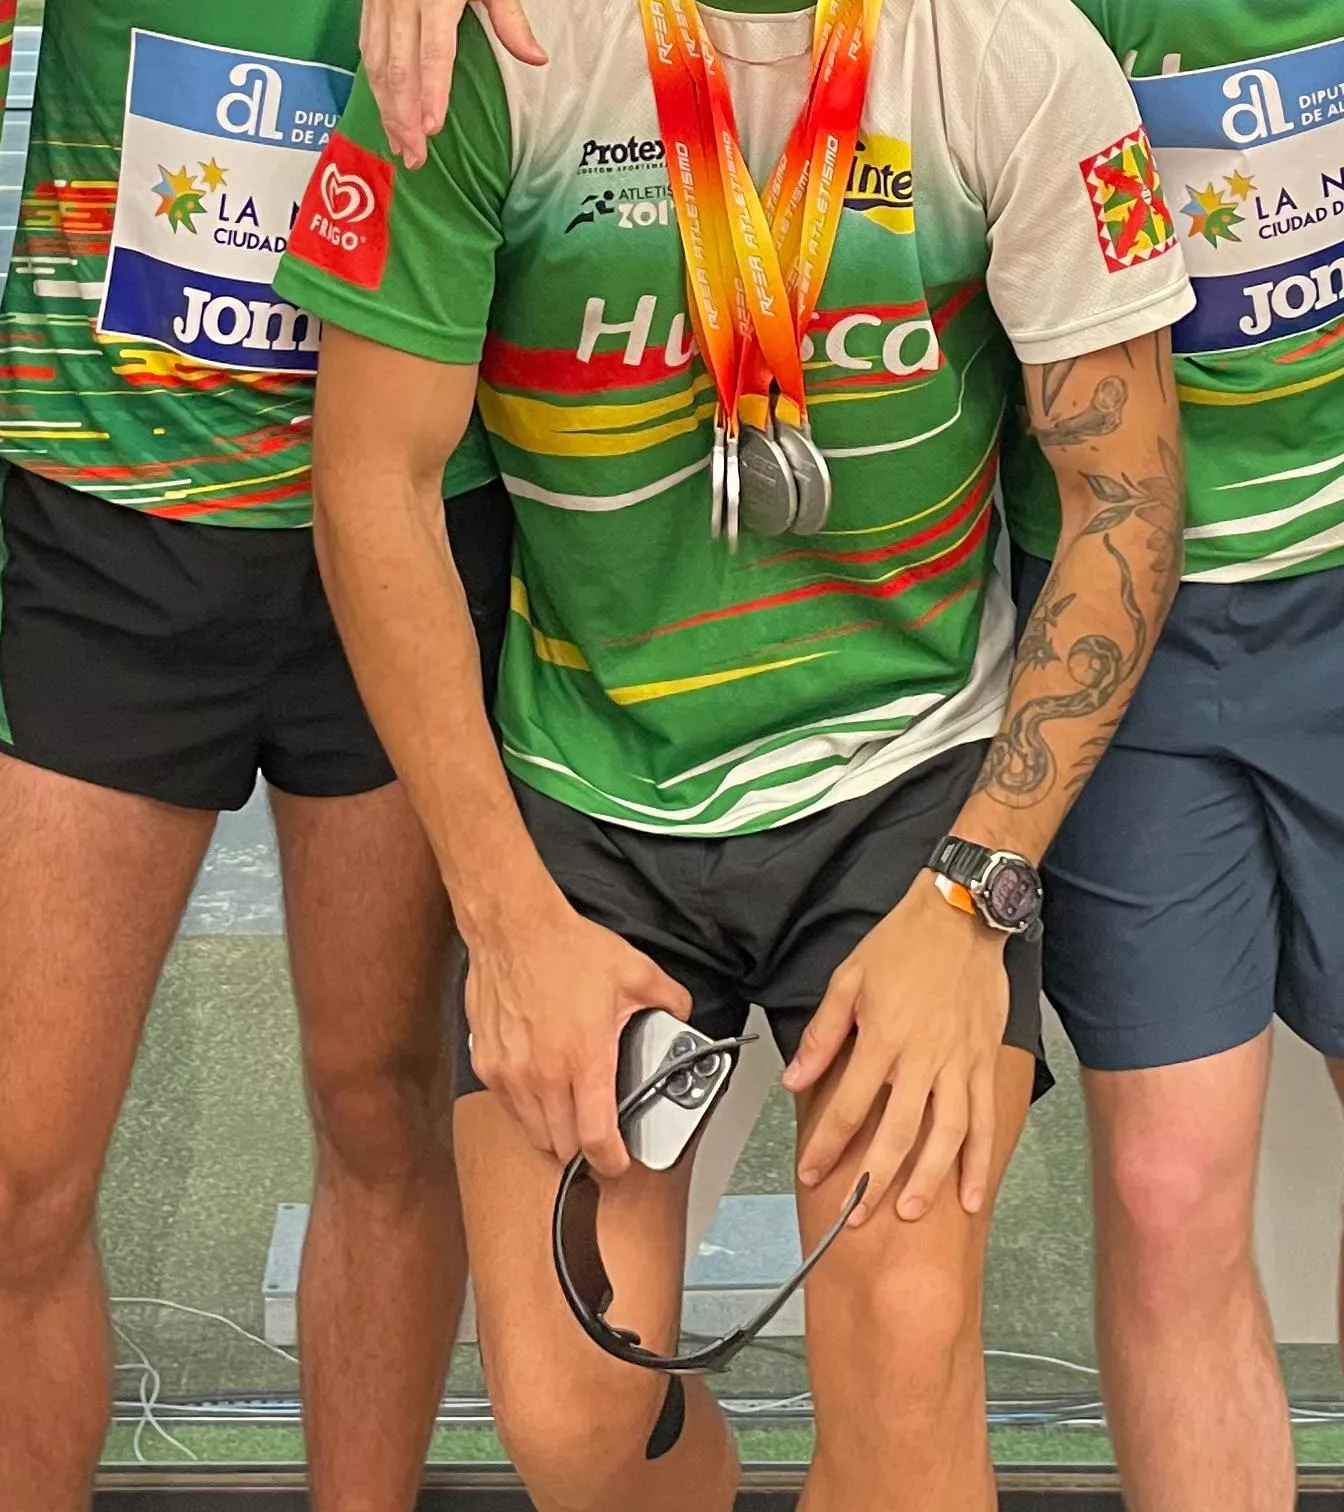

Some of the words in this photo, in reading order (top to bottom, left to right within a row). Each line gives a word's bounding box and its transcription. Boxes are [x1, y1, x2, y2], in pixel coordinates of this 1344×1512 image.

[1301, 108, 1323, 127] DE
[291, 128, 313, 144] DE
[219, 192, 259, 226] LA
[1256, 189, 1297, 221] LA
[310, 215, 357, 250] FRIGO
[1258, 207, 1327, 240] CIUDAD
[214, 227, 287, 253] CIUDAD
